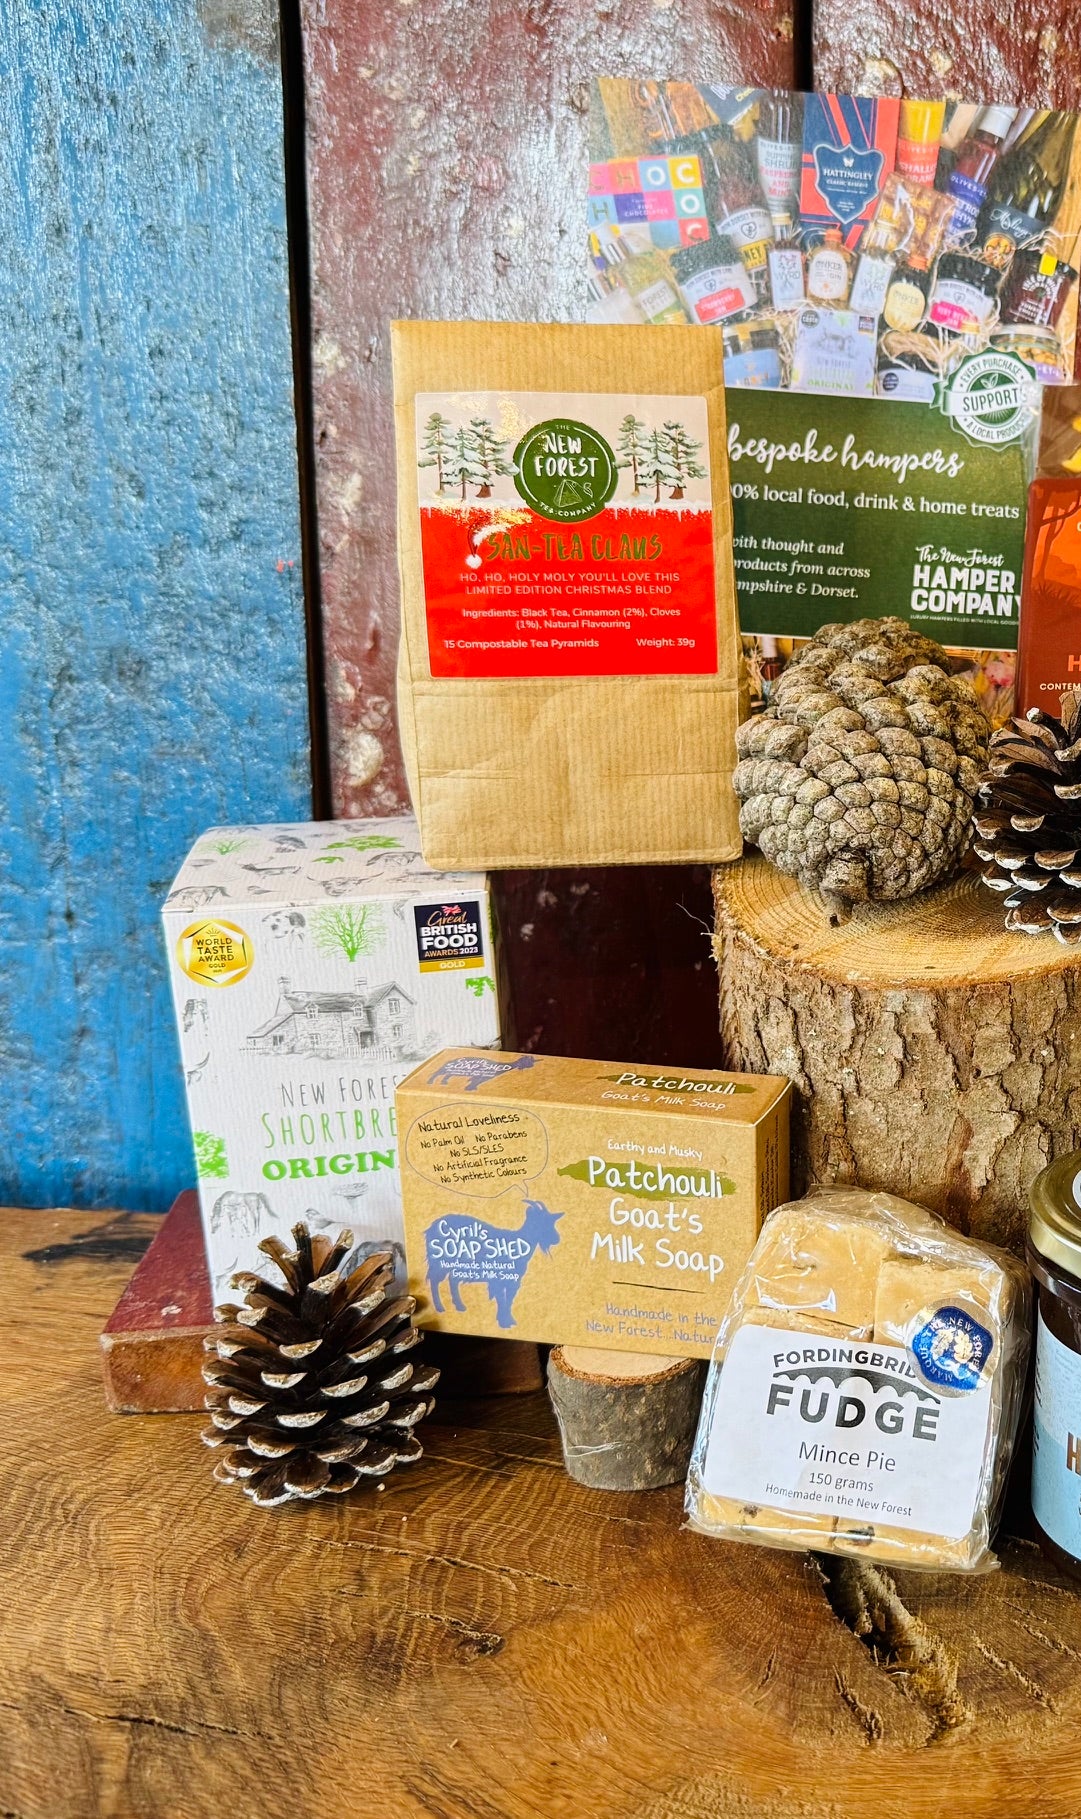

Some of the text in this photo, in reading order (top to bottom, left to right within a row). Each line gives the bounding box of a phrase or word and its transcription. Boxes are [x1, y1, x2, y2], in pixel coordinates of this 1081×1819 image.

[823, 168, 873, 180] HATTINGLEY
[960, 358, 1021, 382] EVERY PURCHASE
[972, 424, 994, 440] LOCAL
[543, 432, 582, 454] NEW
[727, 423, 964, 484] bespoke hampers
[534, 456, 599, 477] FOREST
[763, 485, 1020, 519] local food, drink & home treats
[487, 533, 663, 561] SAN-TEA CLAUS
[761, 537, 844, 555] thought and
[510, 573, 680, 582] HOLY MOLY YOU'LL LOVE THIS
[788, 558, 826, 576] from
[828, 565, 870, 578] across
[913, 564, 1015, 593] HAMPER
[466, 586, 672, 595] LIMITED EDITION CHRISTMAS BLEND
[810, 584, 859, 598] Dorset.
[462, 607, 681, 619] Ingredients: Black Tea, Cinnamon Cloves
[544, 619, 631, 630] Natural Flavouring
[457, 638, 599, 650] Compostable Tea Pyramids
[636, 638, 695, 649] Weight: 39g
[428, 911, 467, 926] Great
[421, 922, 477, 937] BRITISH
[196, 937, 232, 946] WORLD
[197, 945, 233, 955] TASTE
[421, 933, 478, 951] FOOD
[199, 954, 235, 963] AWARD
[425, 946, 479, 958] AWARDS 2023
[440, 960, 466, 969] GOLD
[616, 1072, 736, 1095] Patchouli
[281, 1081, 326, 1108] NEW
[601, 1090, 726, 1111] Goat's Milk Soap
[262, 1107, 397, 1149] SHORTBRE
[418, 1113, 520, 1132] Natural Loveliness
[432, 1130, 527, 1147] Palm Parabens
[462, 1143, 504, 1156] SLS/SLES
[607, 1138, 703, 1161] Earthy and Musky
[262, 1149, 397, 1181] ORIGIN
[447, 1154, 528, 1170] Artificial Fragrance
[453, 1167, 527, 1183] Synthetic Colours
[587, 1155, 723, 1199] Patchouli
[609, 1197, 703, 1236] Goat's
[439, 1219, 489, 1241] Cyril's
[430, 1238, 532, 1260] SOAP SHED
[590, 1232, 725, 1283] Milk Soap
[440, 1258, 515, 1271] Handmade Natural
[605, 1302, 718, 1327] Handmade the
[585, 1319, 614, 1333] New
[773, 1348, 916, 1379] FORDINGBRI
[766, 1383, 940, 1442] FUDGE
[799, 1441, 897, 1472] Mince Pie
[809, 1471, 874, 1493] 150 grams
[765, 1482, 913, 1517] Homemade the New Forest
